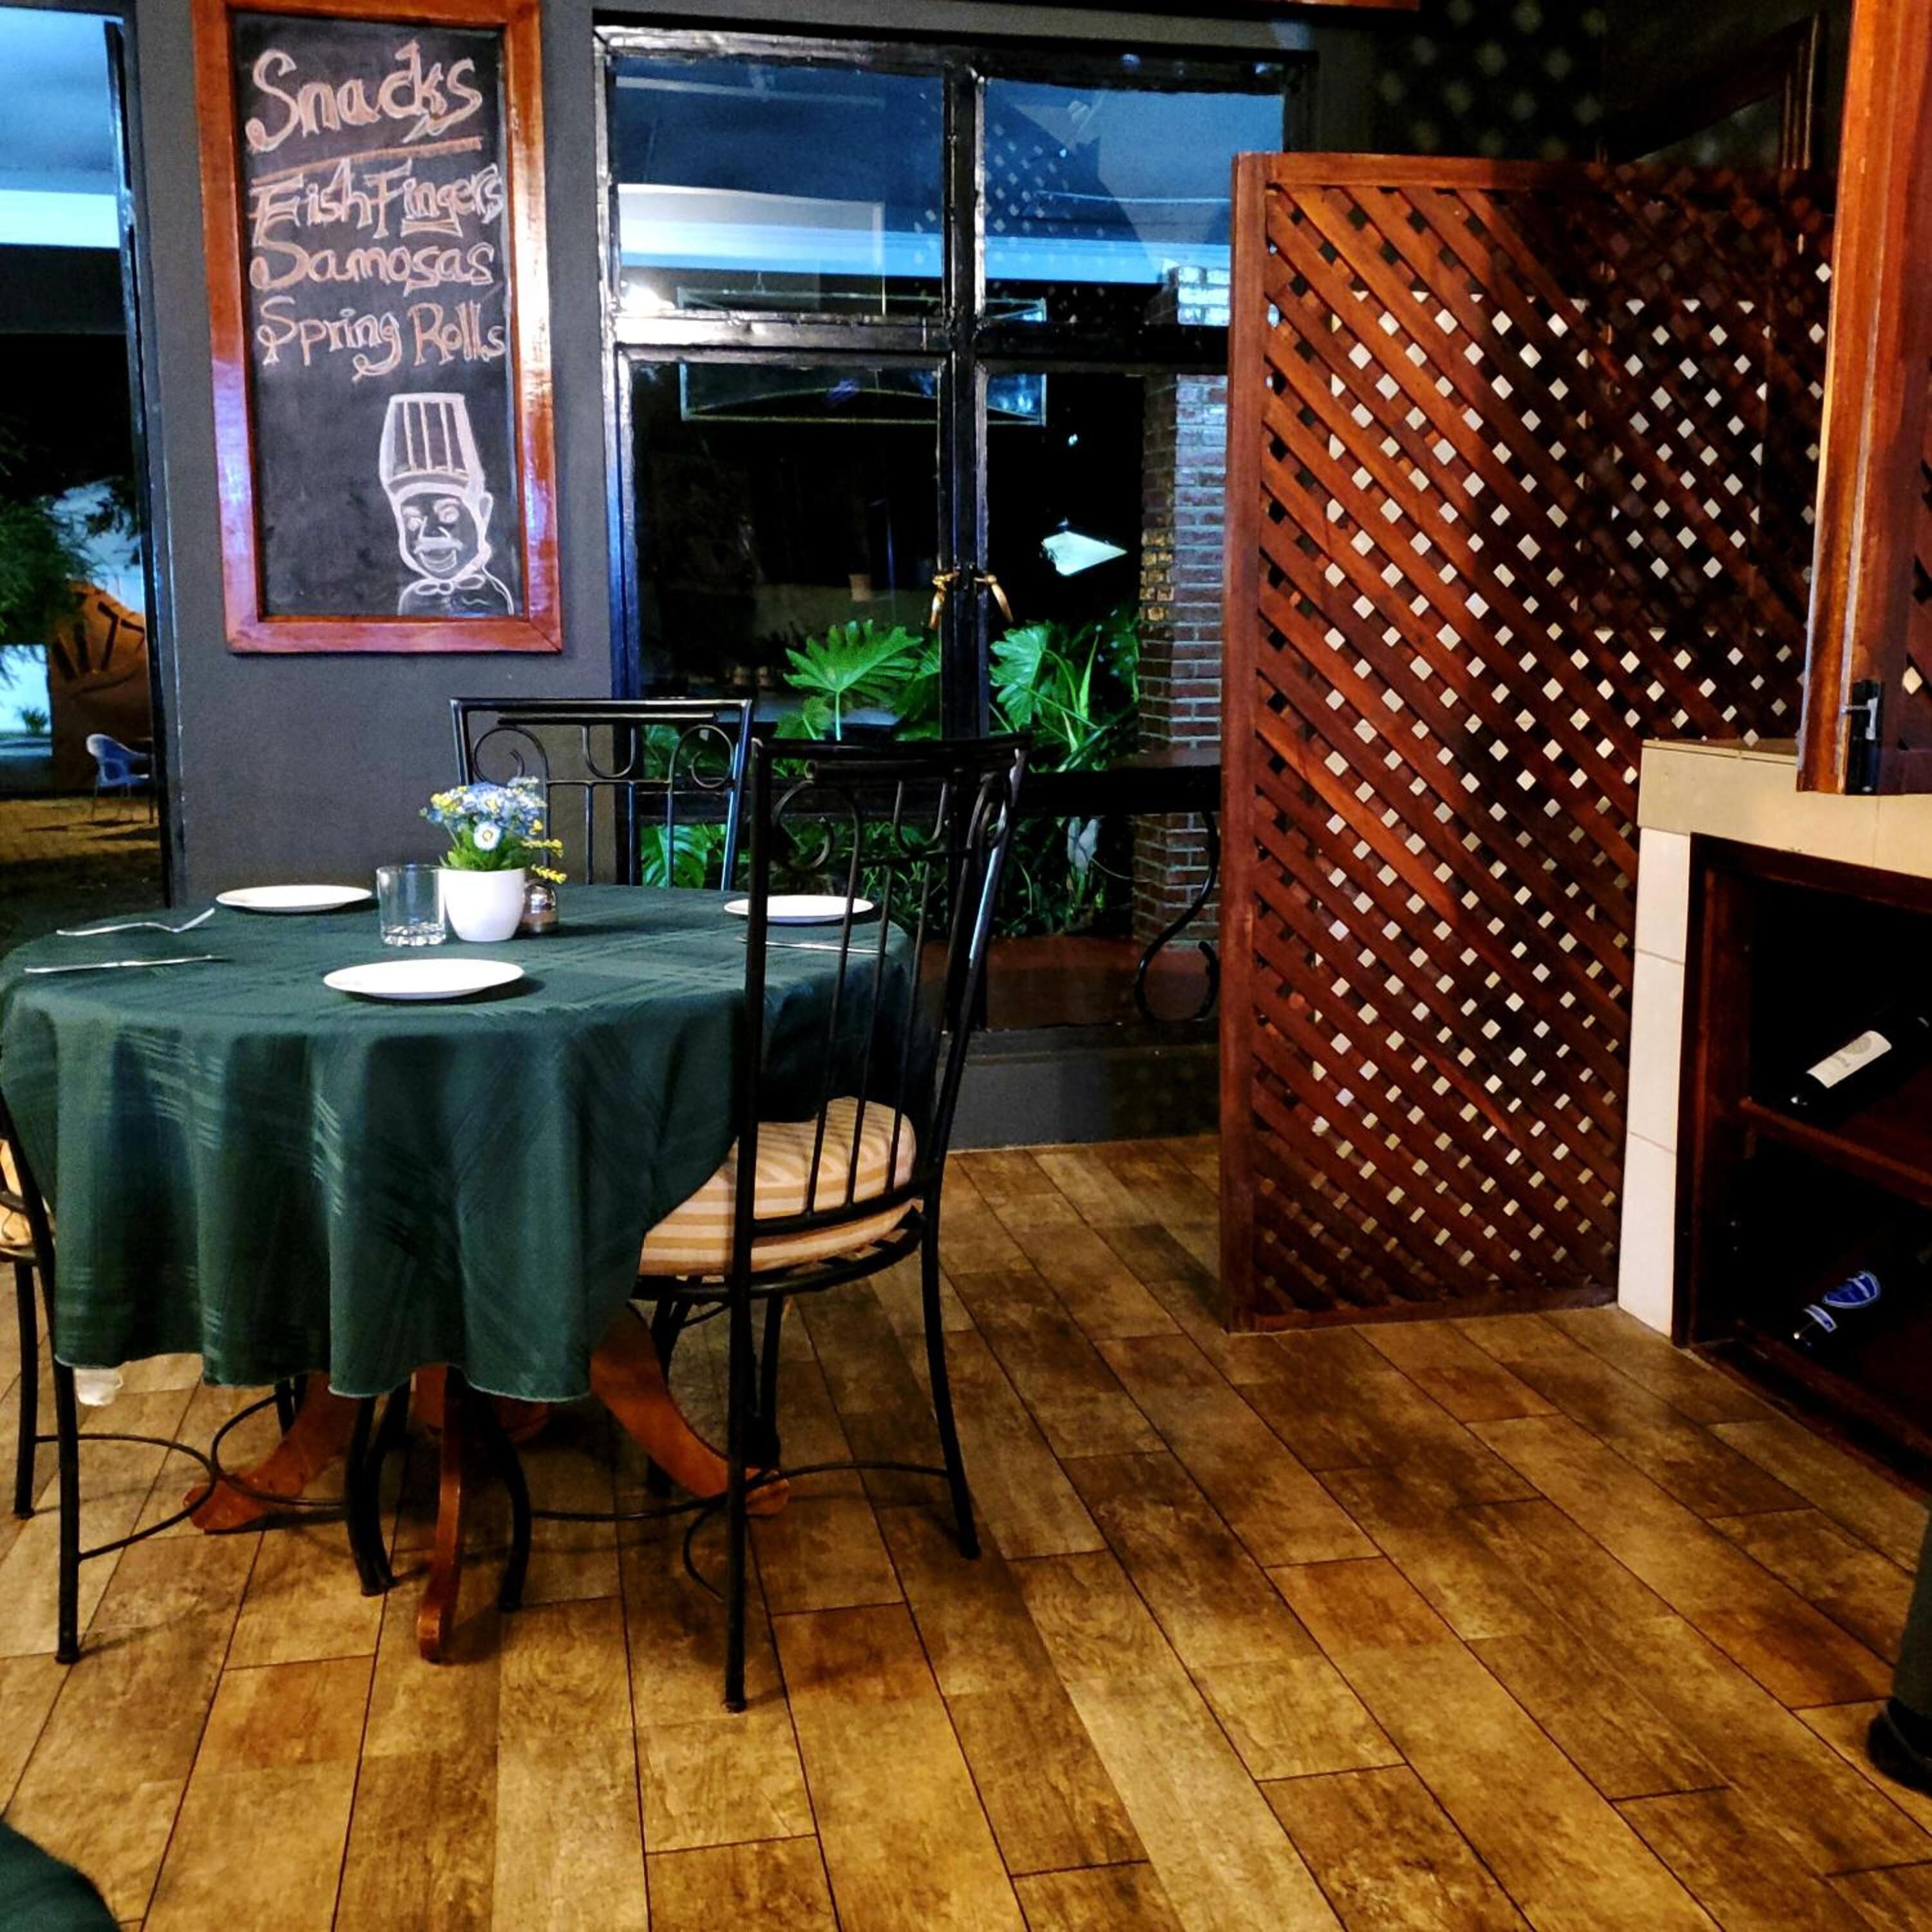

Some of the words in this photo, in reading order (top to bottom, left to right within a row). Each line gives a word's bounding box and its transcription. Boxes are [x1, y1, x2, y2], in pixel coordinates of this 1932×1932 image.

[245, 39, 482, 152] Snacks
[364, 157, 503, 239] Fingers
[249, 218, 495, 298] Samosas
[257, 296, 402, 383] Spring
[408, 300, 506, 366] Rolls
